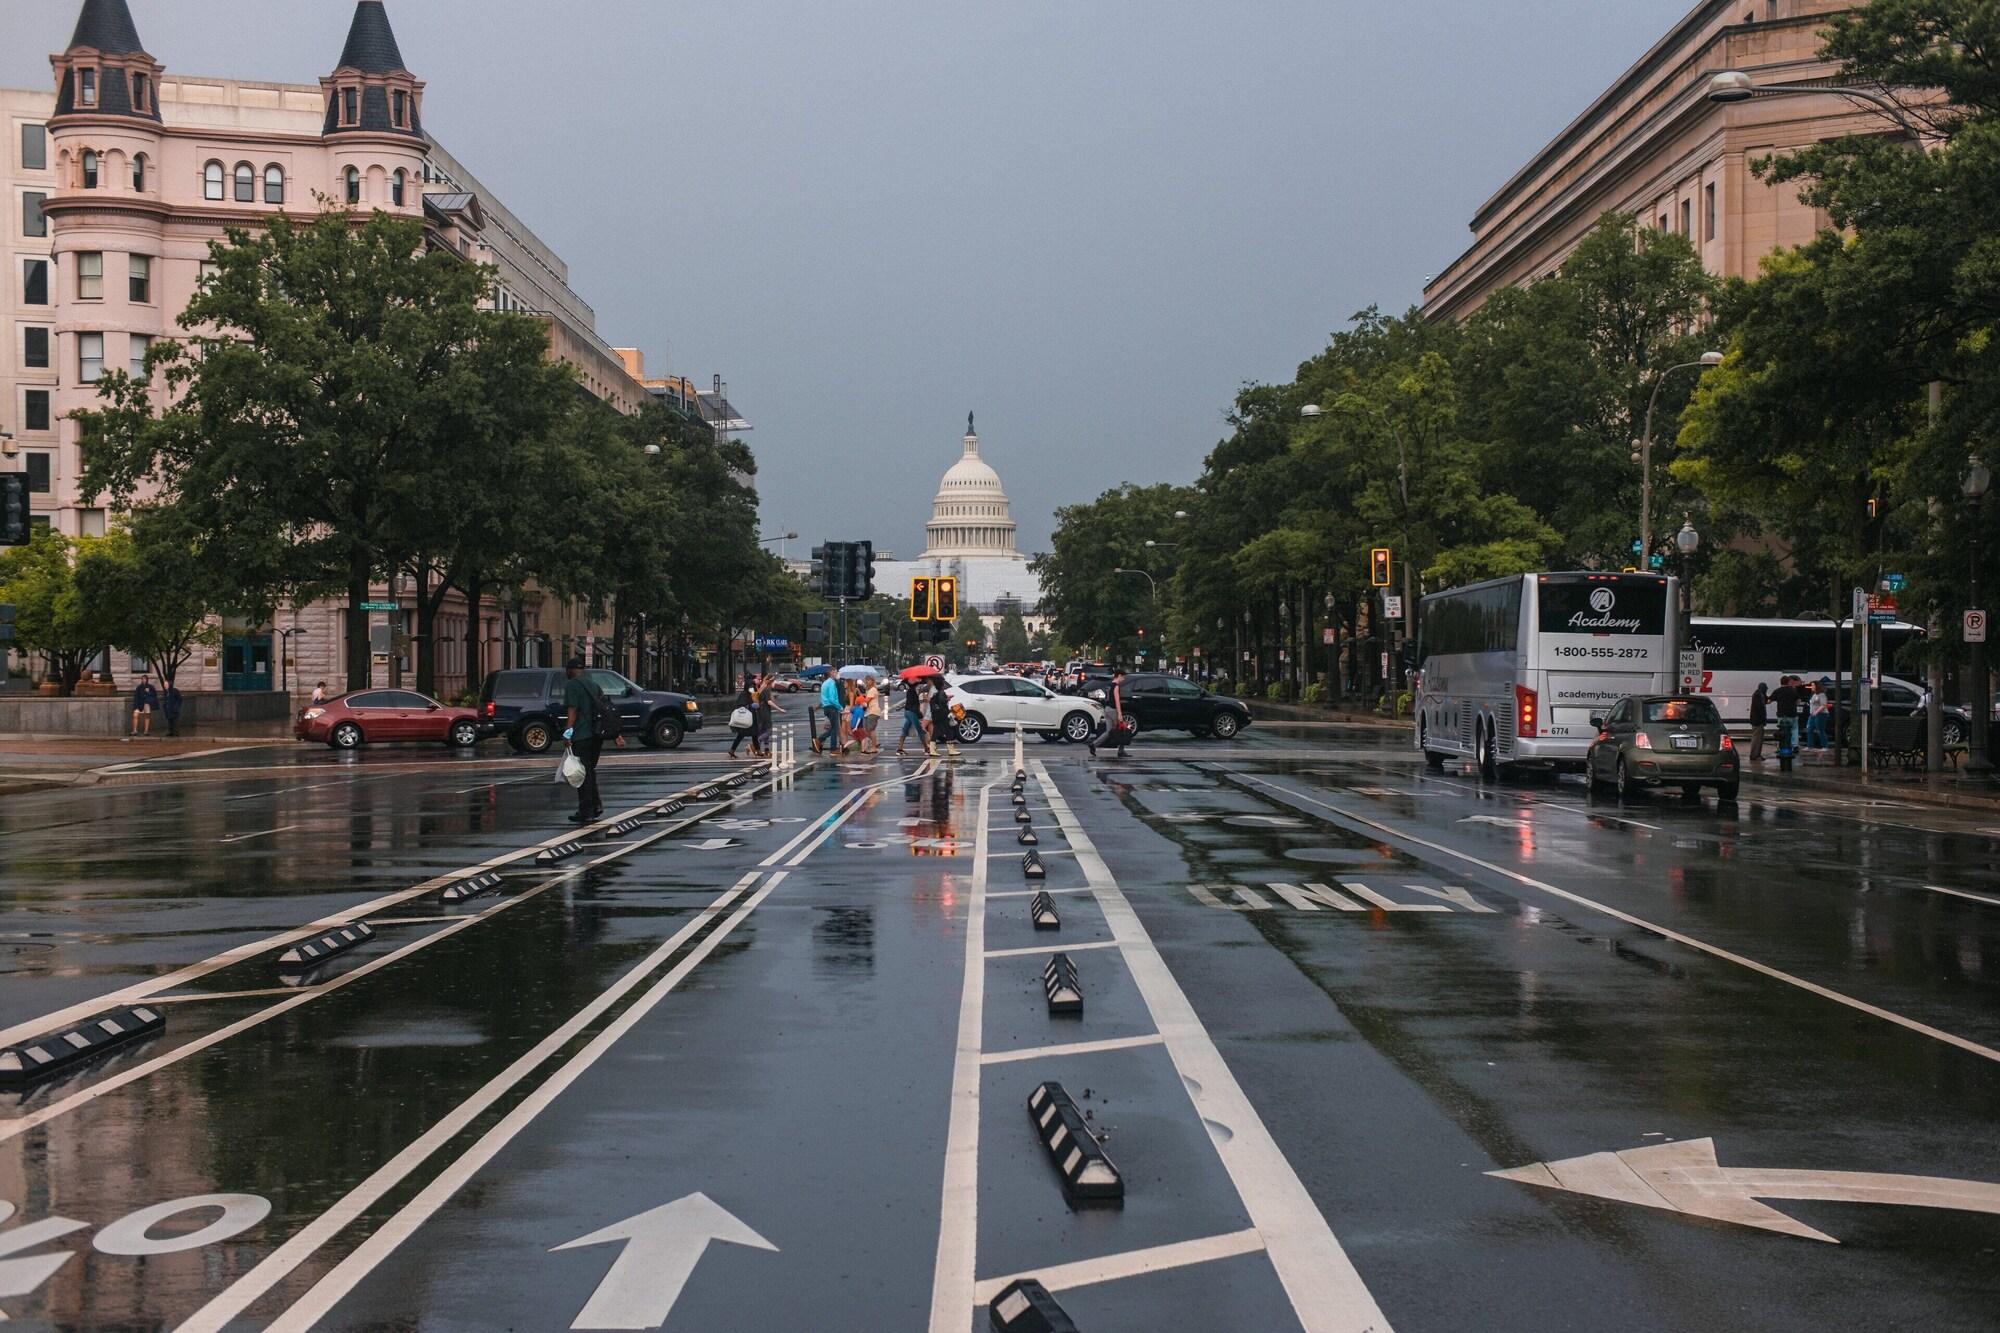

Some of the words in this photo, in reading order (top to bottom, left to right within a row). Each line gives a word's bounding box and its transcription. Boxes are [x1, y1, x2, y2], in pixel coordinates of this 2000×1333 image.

[1568, 611, 1640, 632] Academy
[1554, 647, 1648, 658] 1-800-555-2872
[1694, 639, 1726, 655] Service
[1681, 653, 1694, 661] NO
[1551, 727, 1569, 735] 6774
[1185, 882, 1498, 914] ONLY
